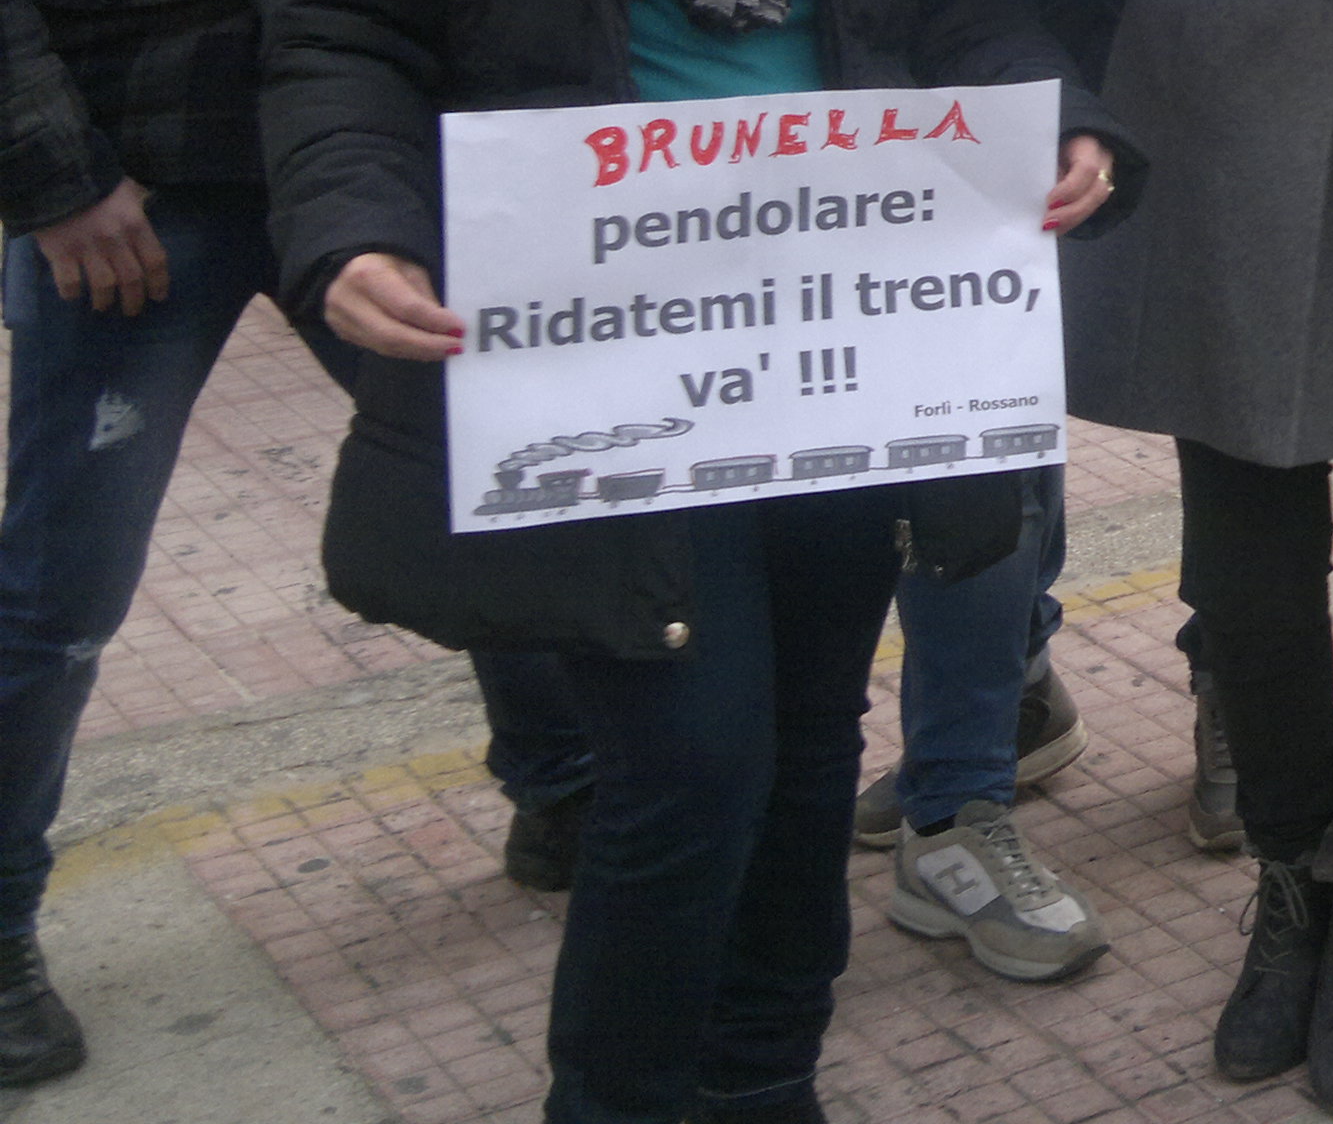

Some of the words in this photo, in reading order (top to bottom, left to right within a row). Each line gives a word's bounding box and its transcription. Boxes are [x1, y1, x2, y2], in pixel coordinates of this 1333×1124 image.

[584, 100, 981, 188] BRUNELLA
[593, 188, 935, 265] pendolare:
[477, 277, 776, 353] Ridatemi
[801, 273, 833, 322] il
[855, 267, 1042, 318] treno,
[680, 352, 770, 408] va'
[798, 345, 859, 397] !!!
[968, 395, 1039, 412] Rossano
